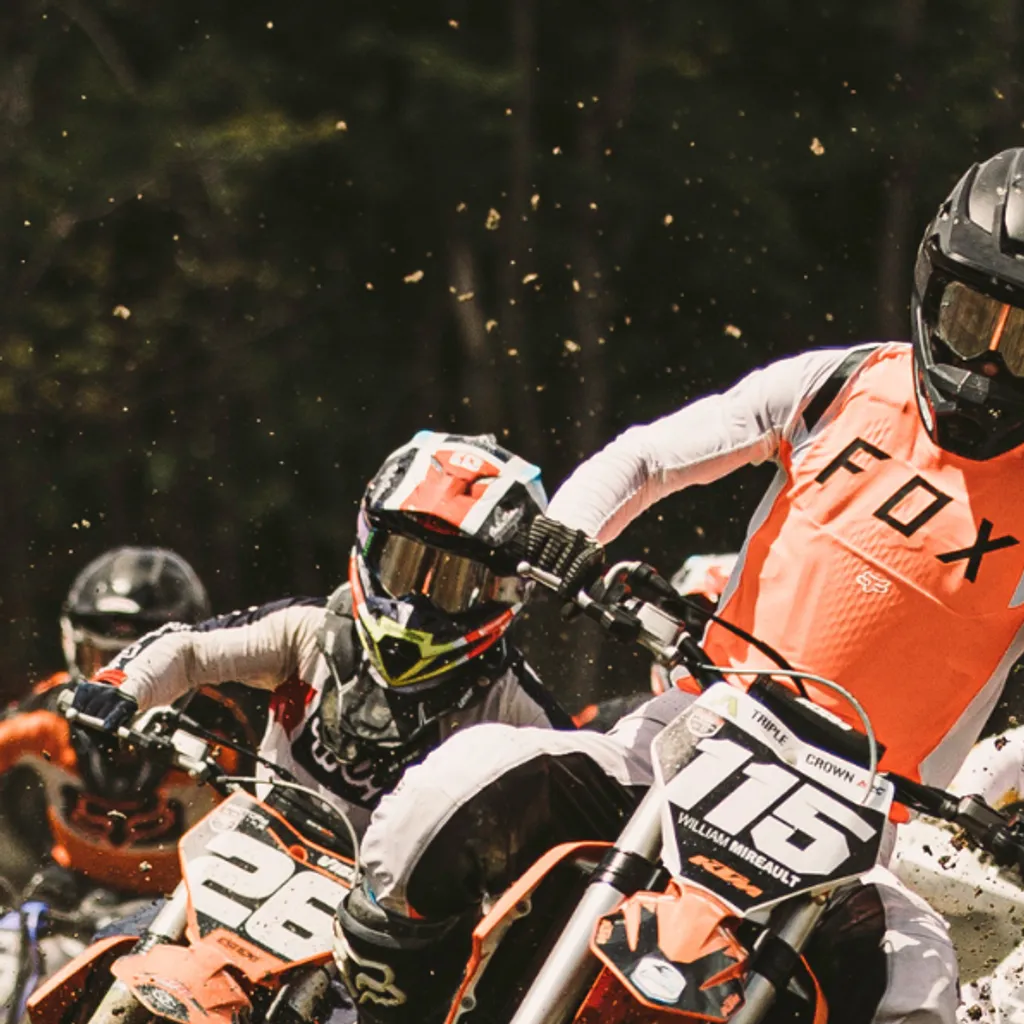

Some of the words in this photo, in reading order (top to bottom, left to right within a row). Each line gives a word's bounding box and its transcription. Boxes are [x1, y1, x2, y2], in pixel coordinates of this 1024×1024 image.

[814, 437, 1019, 583] FOX
[751, 708, 790, 746] TRIPLE
[805, 752, 856, 784] CROWN
[665, 738, 878, 876] 115
[677, 811, 731, 848] WILLIAM
[729, 839, 802, 888] MIREAULT
[188, 830, 351, 962] 26
[688, 854, 764, 898] KTM
